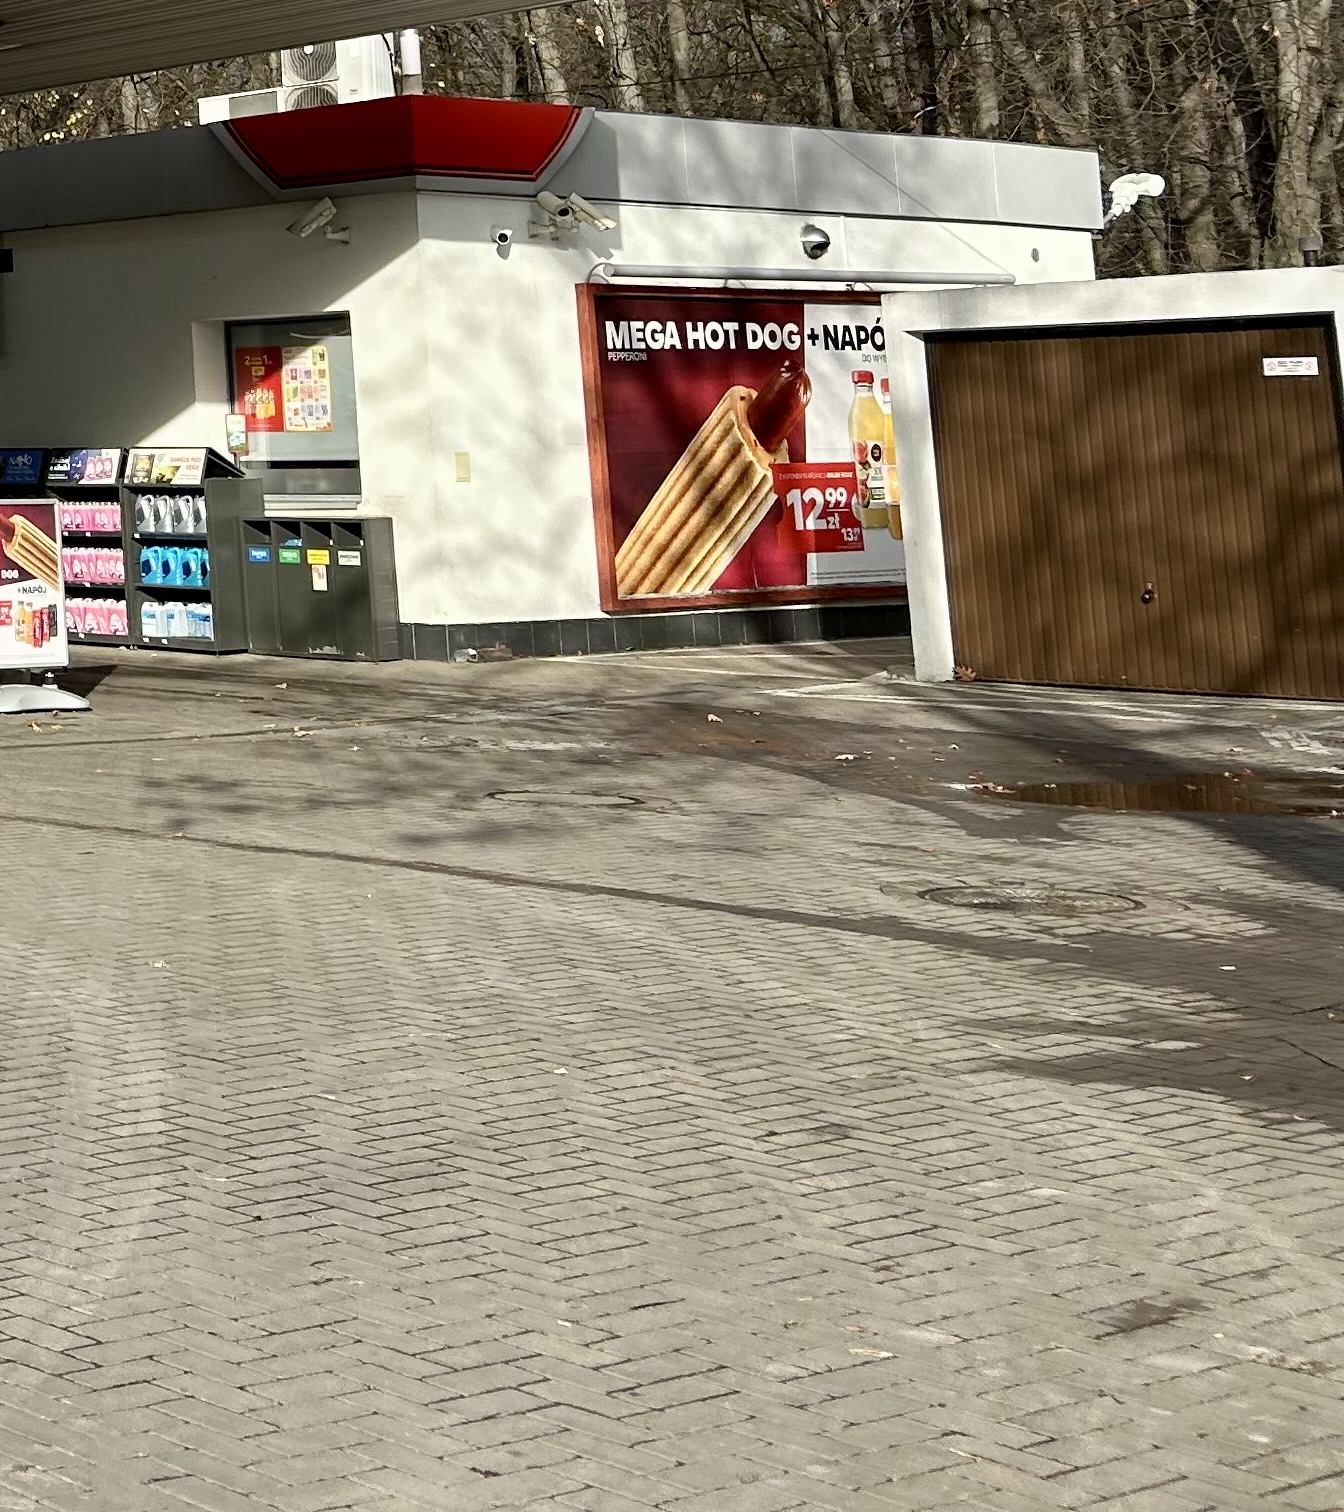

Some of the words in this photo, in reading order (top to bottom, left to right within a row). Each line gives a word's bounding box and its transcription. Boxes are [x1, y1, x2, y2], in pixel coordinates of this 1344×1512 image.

[605, 320, 682, 350] MEGA
[686, 321, 739, 350] HOT
[745, 322, 801, 351] DOG
[1, 569, 20, 579] DOG
